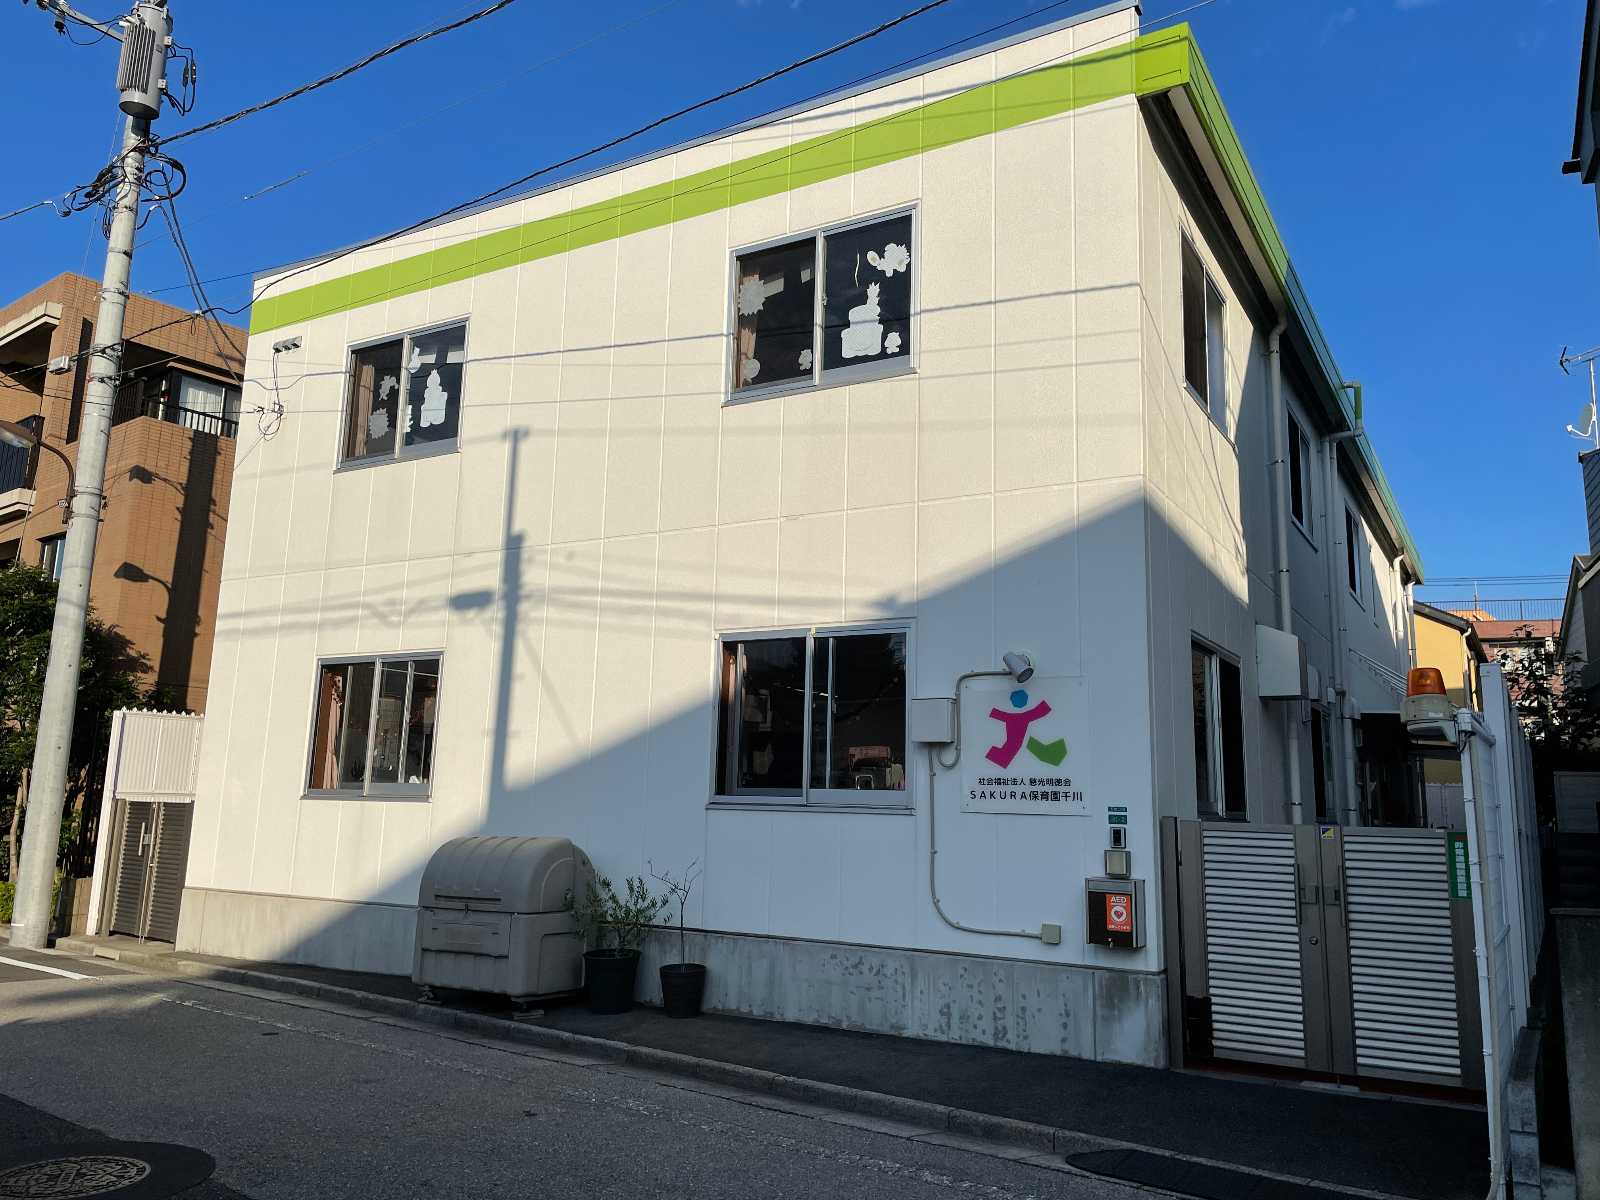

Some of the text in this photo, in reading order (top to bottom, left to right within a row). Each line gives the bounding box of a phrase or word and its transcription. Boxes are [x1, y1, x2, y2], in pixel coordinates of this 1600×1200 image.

[978, 777, 1026, 786] 社会福祉法人
[1111, 895, 1127, 904] AED
